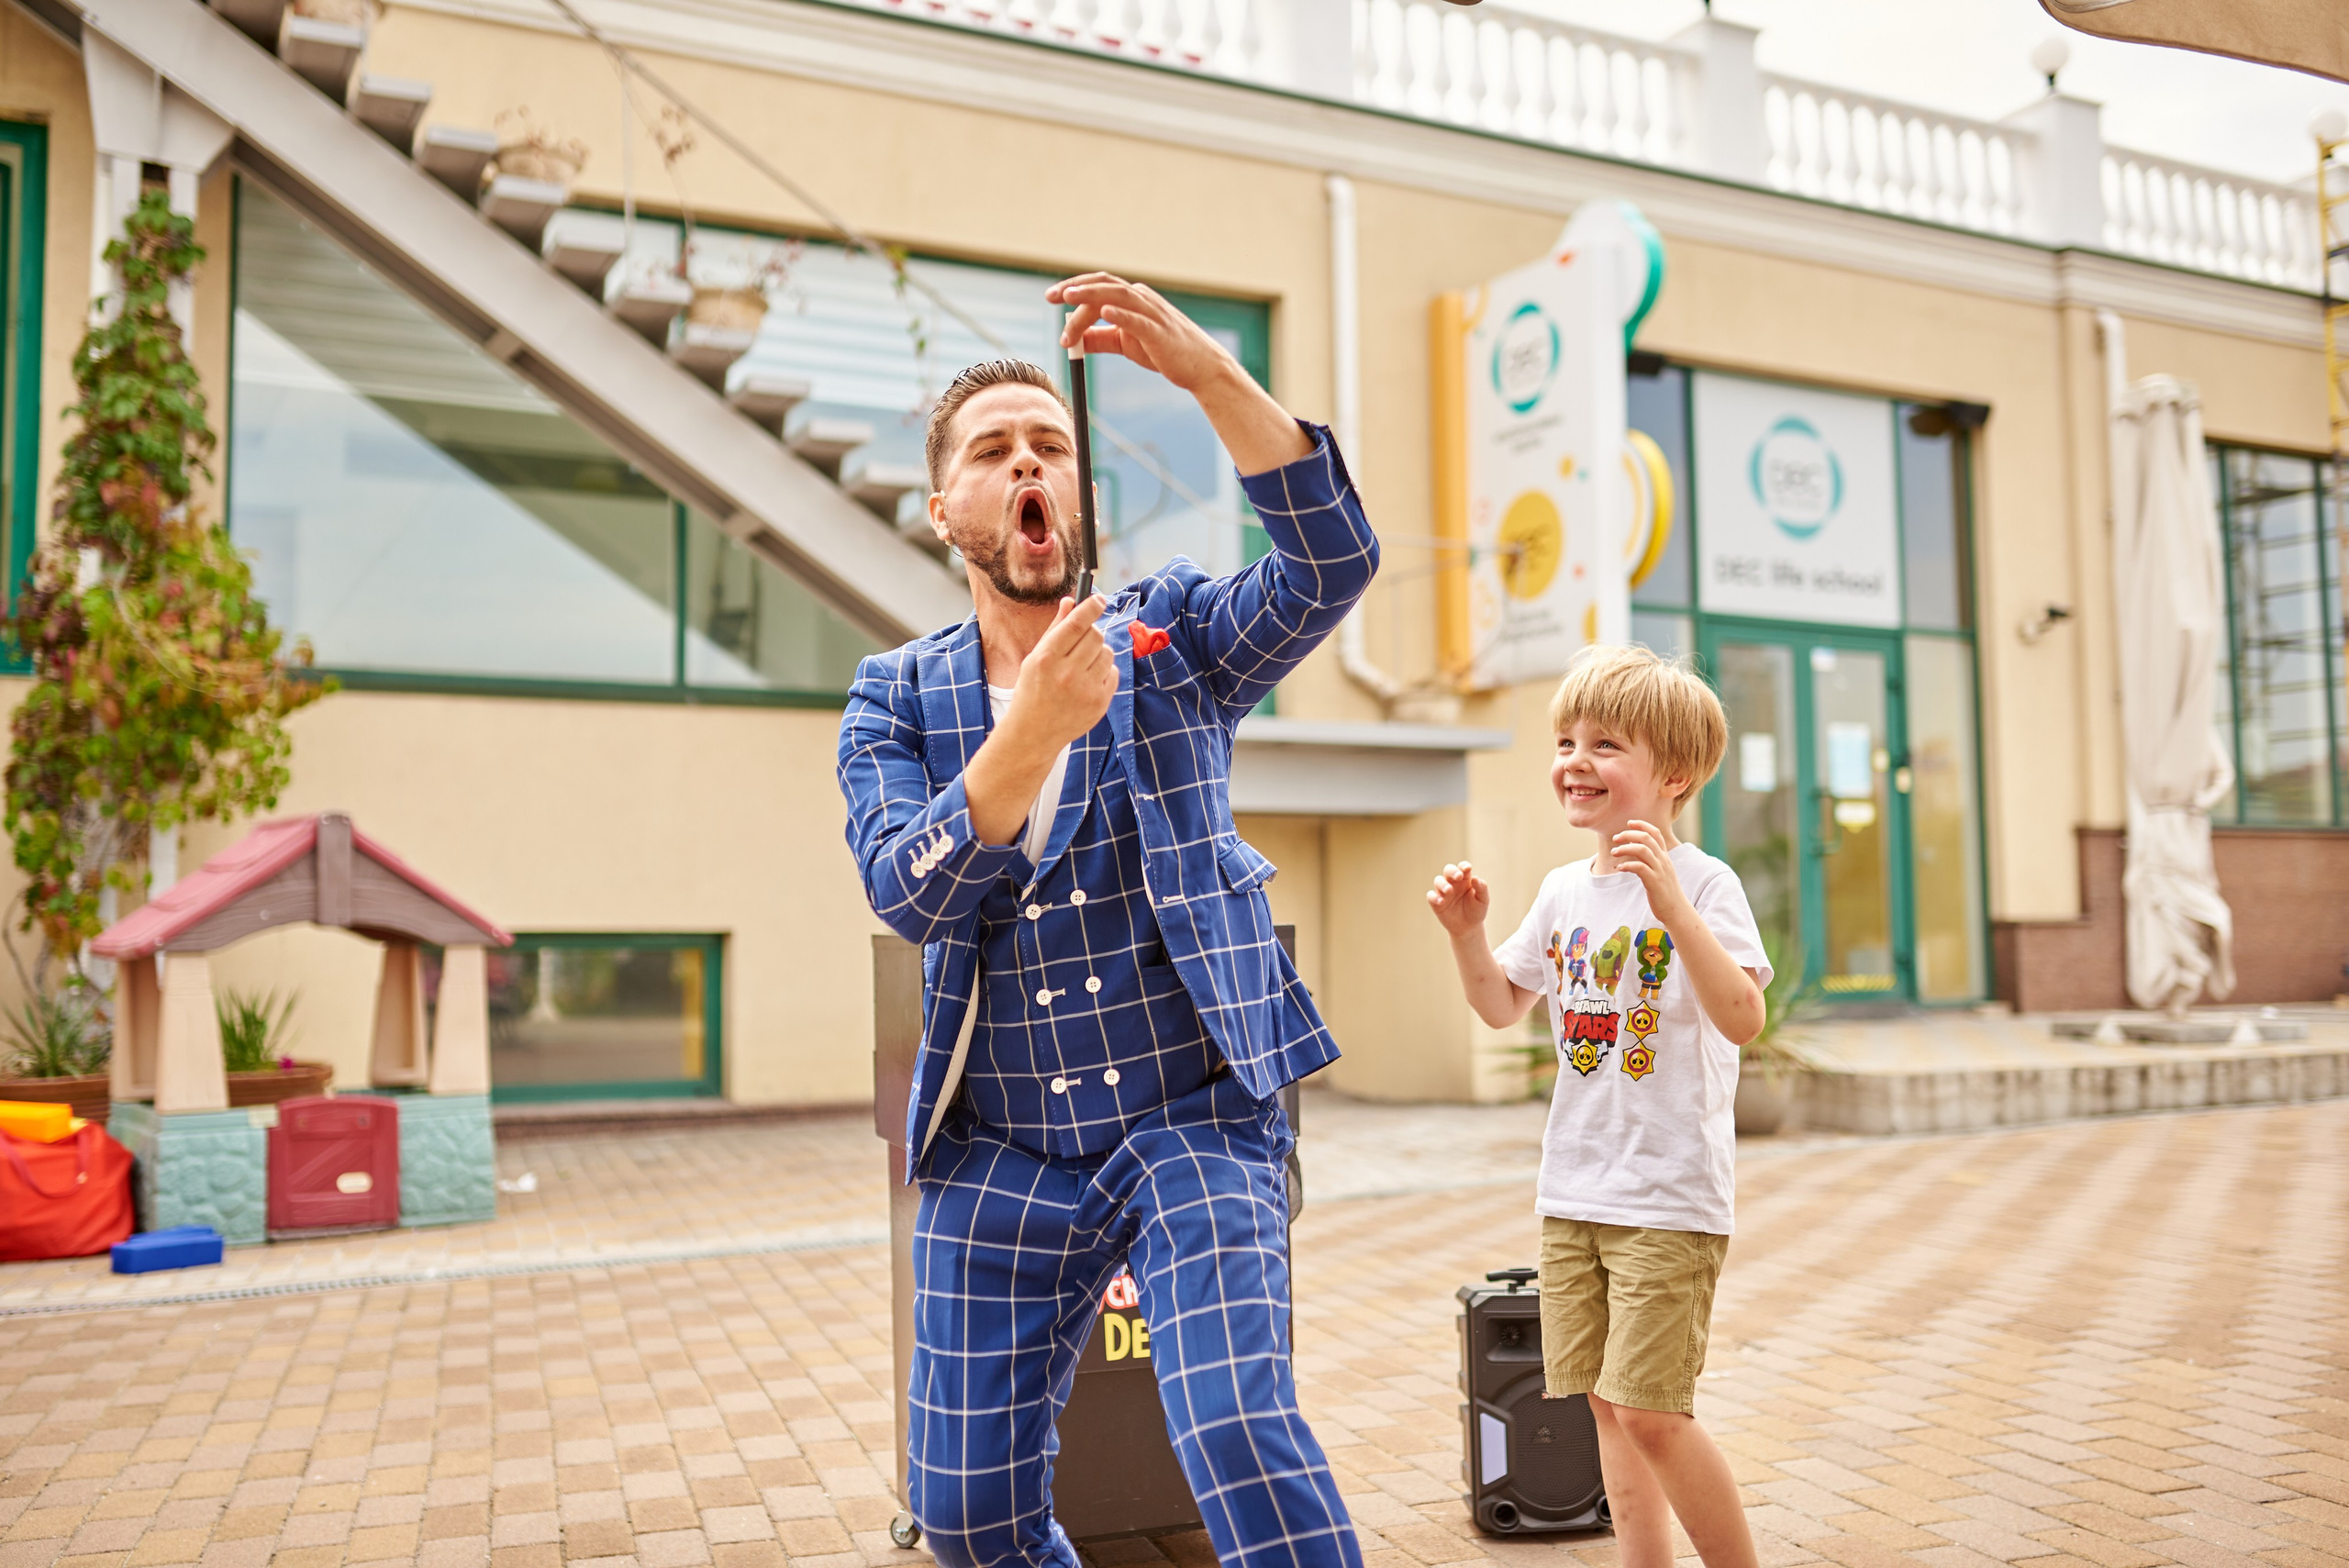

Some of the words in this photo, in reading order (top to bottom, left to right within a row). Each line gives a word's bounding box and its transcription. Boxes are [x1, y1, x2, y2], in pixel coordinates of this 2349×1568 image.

[1772, 556, 1803, 588] life
[1813, 564, 1882, 595] school
[1102, 1275, 1140, 1309] CH
